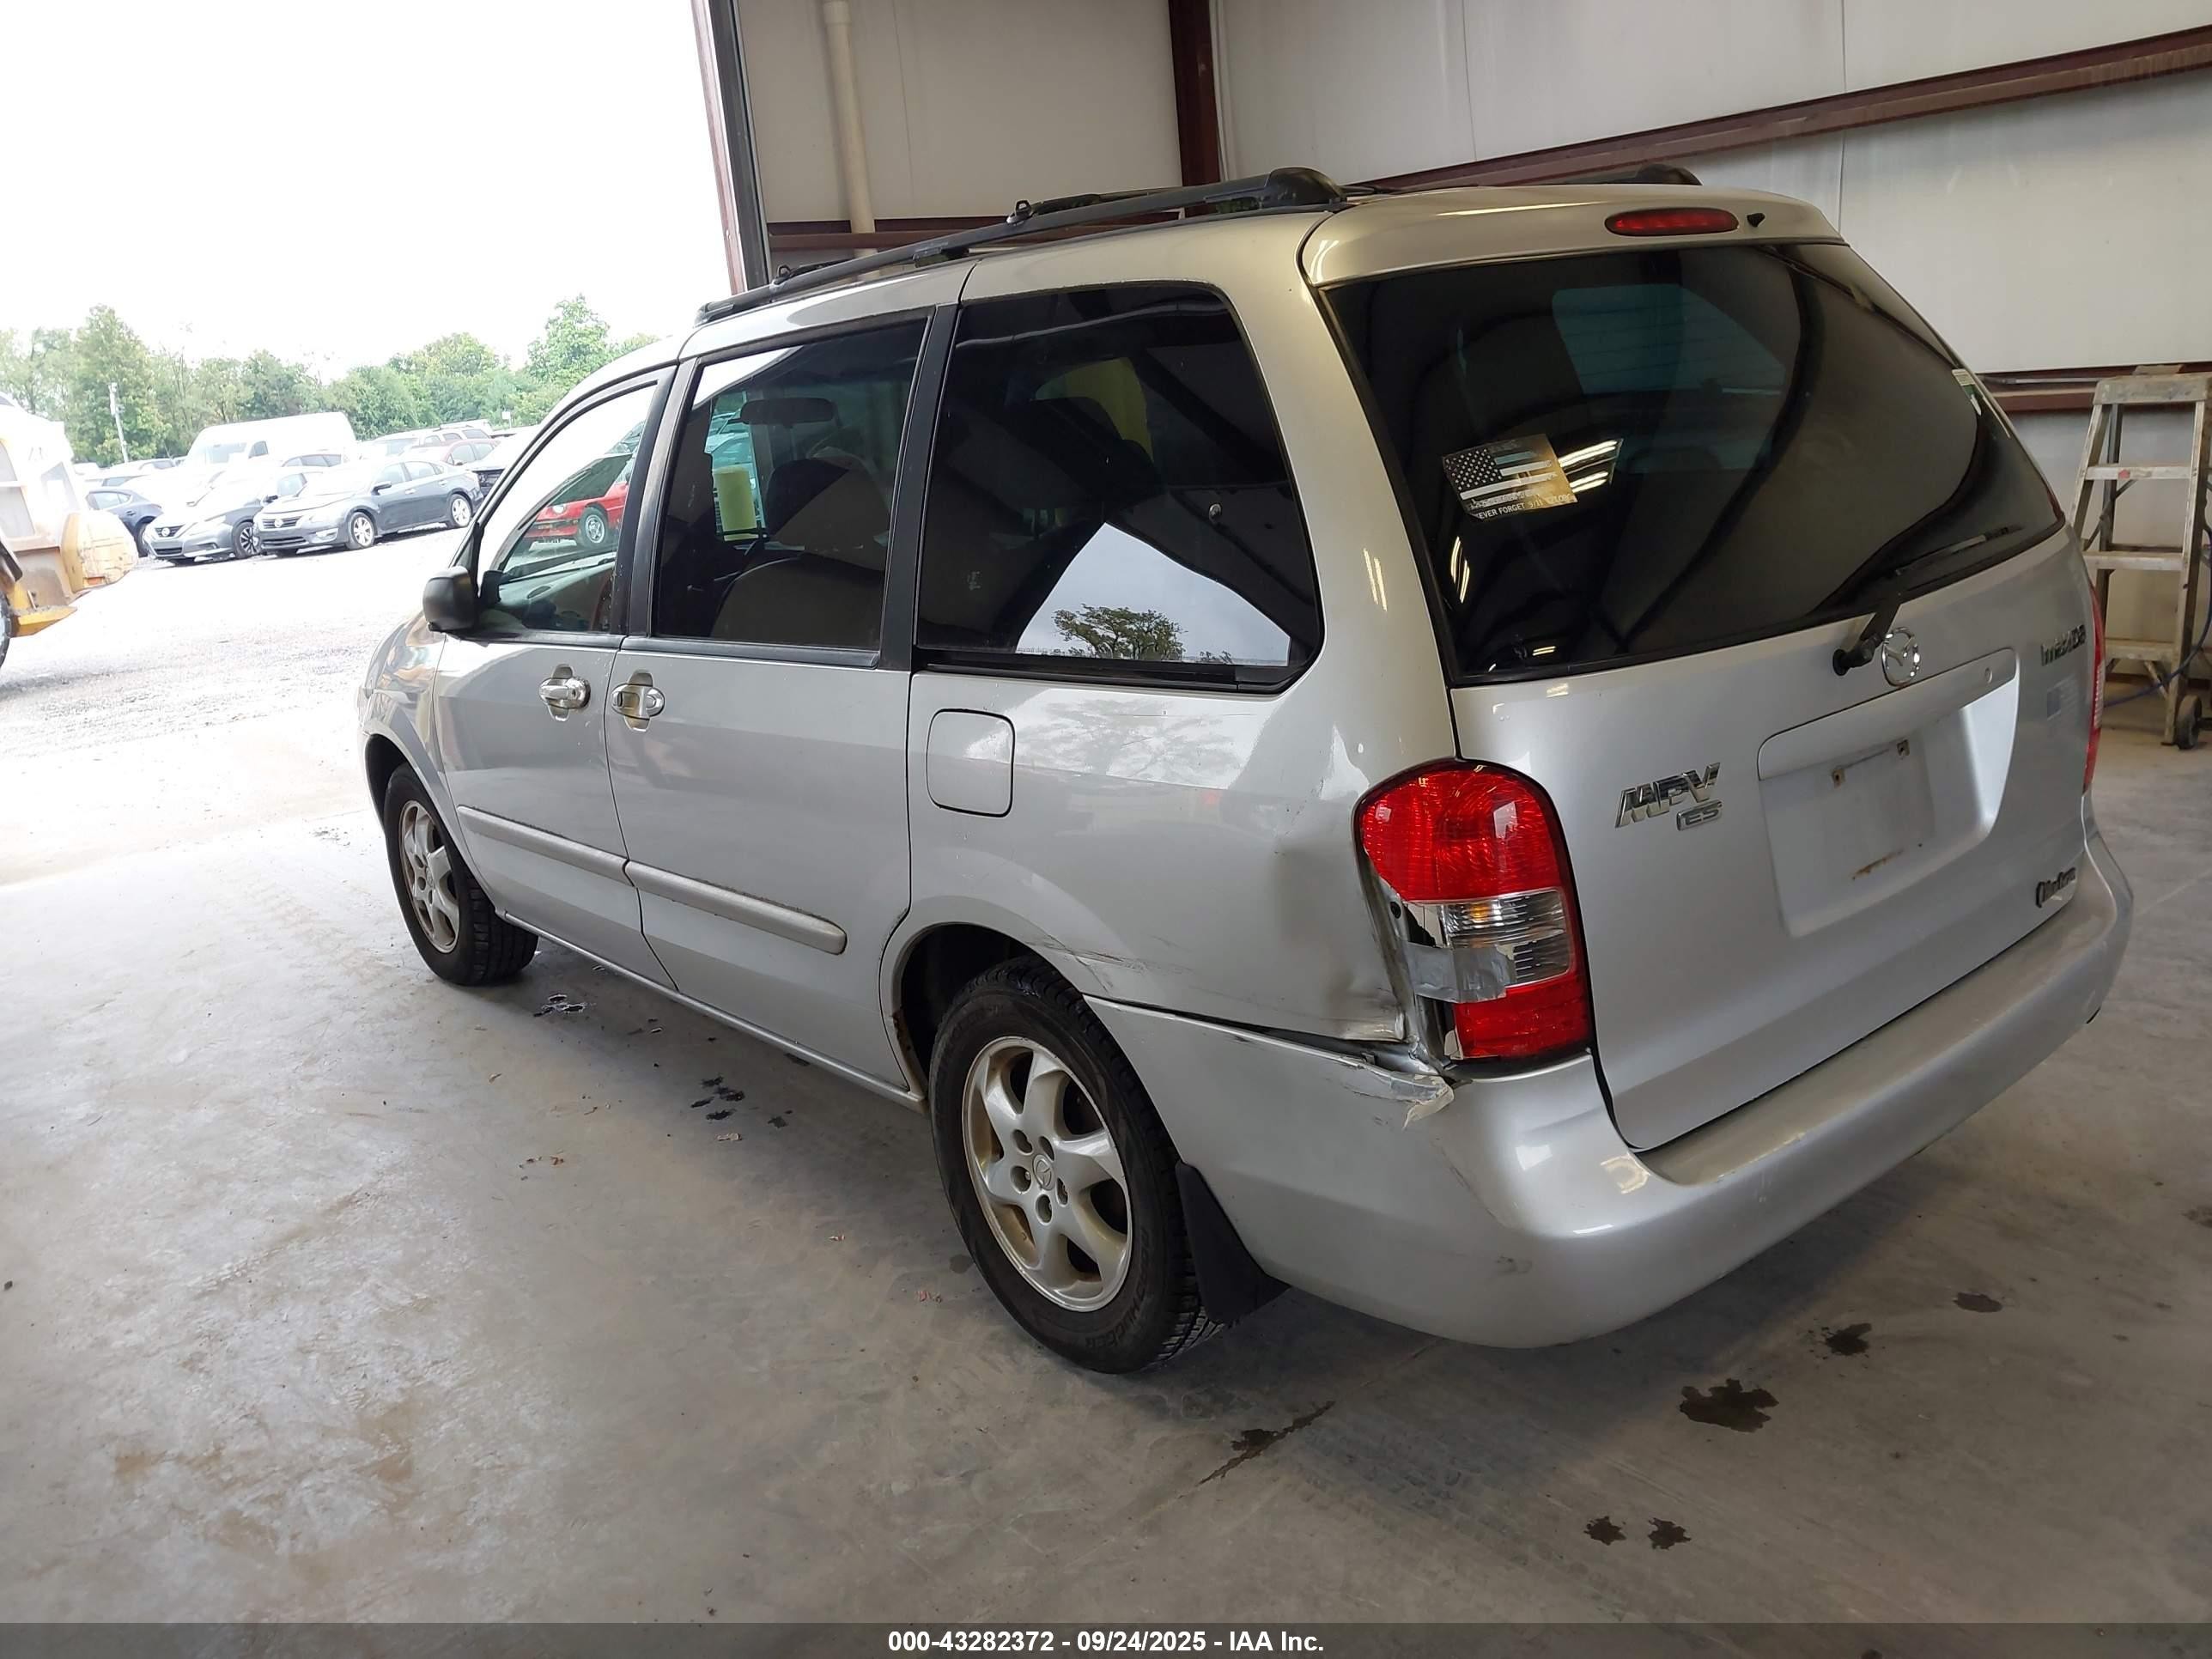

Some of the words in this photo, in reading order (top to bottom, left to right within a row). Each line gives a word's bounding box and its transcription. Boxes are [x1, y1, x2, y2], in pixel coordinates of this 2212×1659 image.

[1476, 508, 1498, 520] EVER
[1498, 502, 1525, 515] FORGET
[1614, 763, 1721, 828] MPV
[1677, 799, 1723, 831] ES
